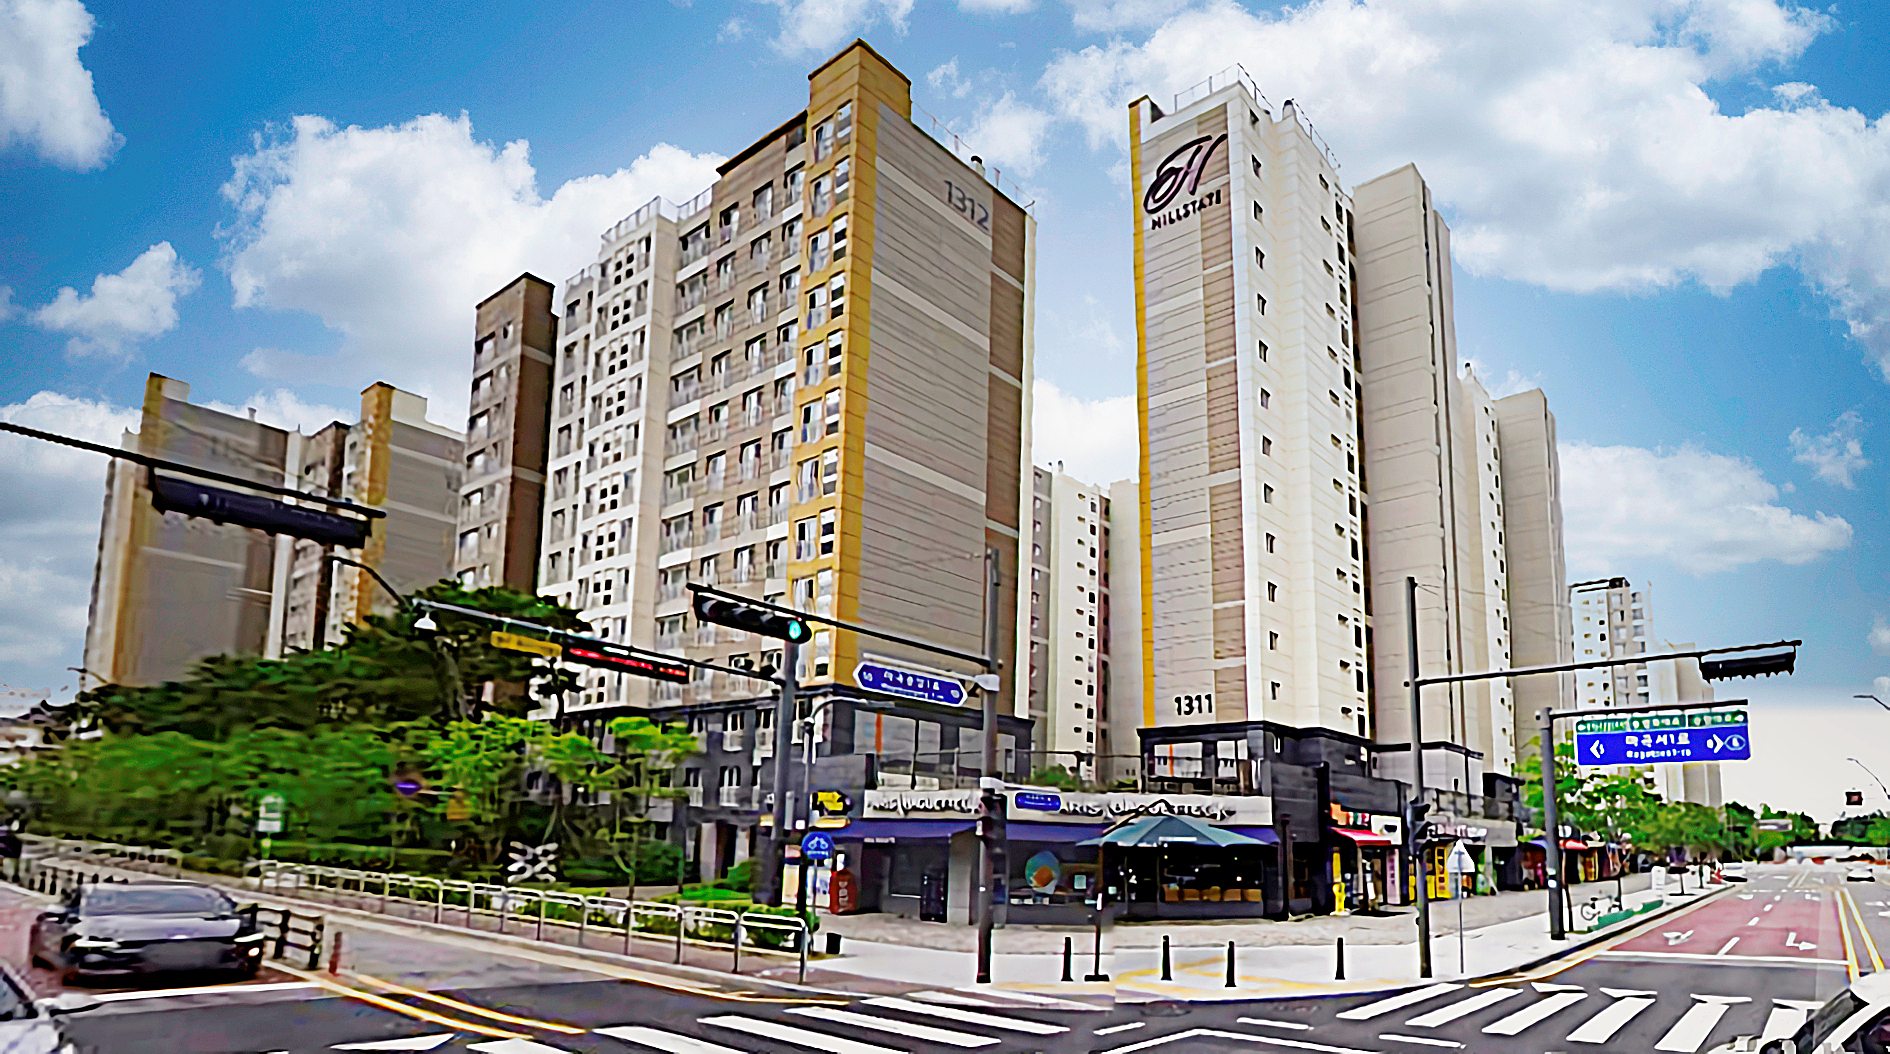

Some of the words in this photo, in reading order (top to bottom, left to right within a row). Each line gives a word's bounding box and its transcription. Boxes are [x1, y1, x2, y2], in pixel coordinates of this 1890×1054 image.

[944, 180, 989, 230] 1312
[1151, 189, 1222, 230] HILLSTATE
[1174, 693, 1213, 716] 1311
